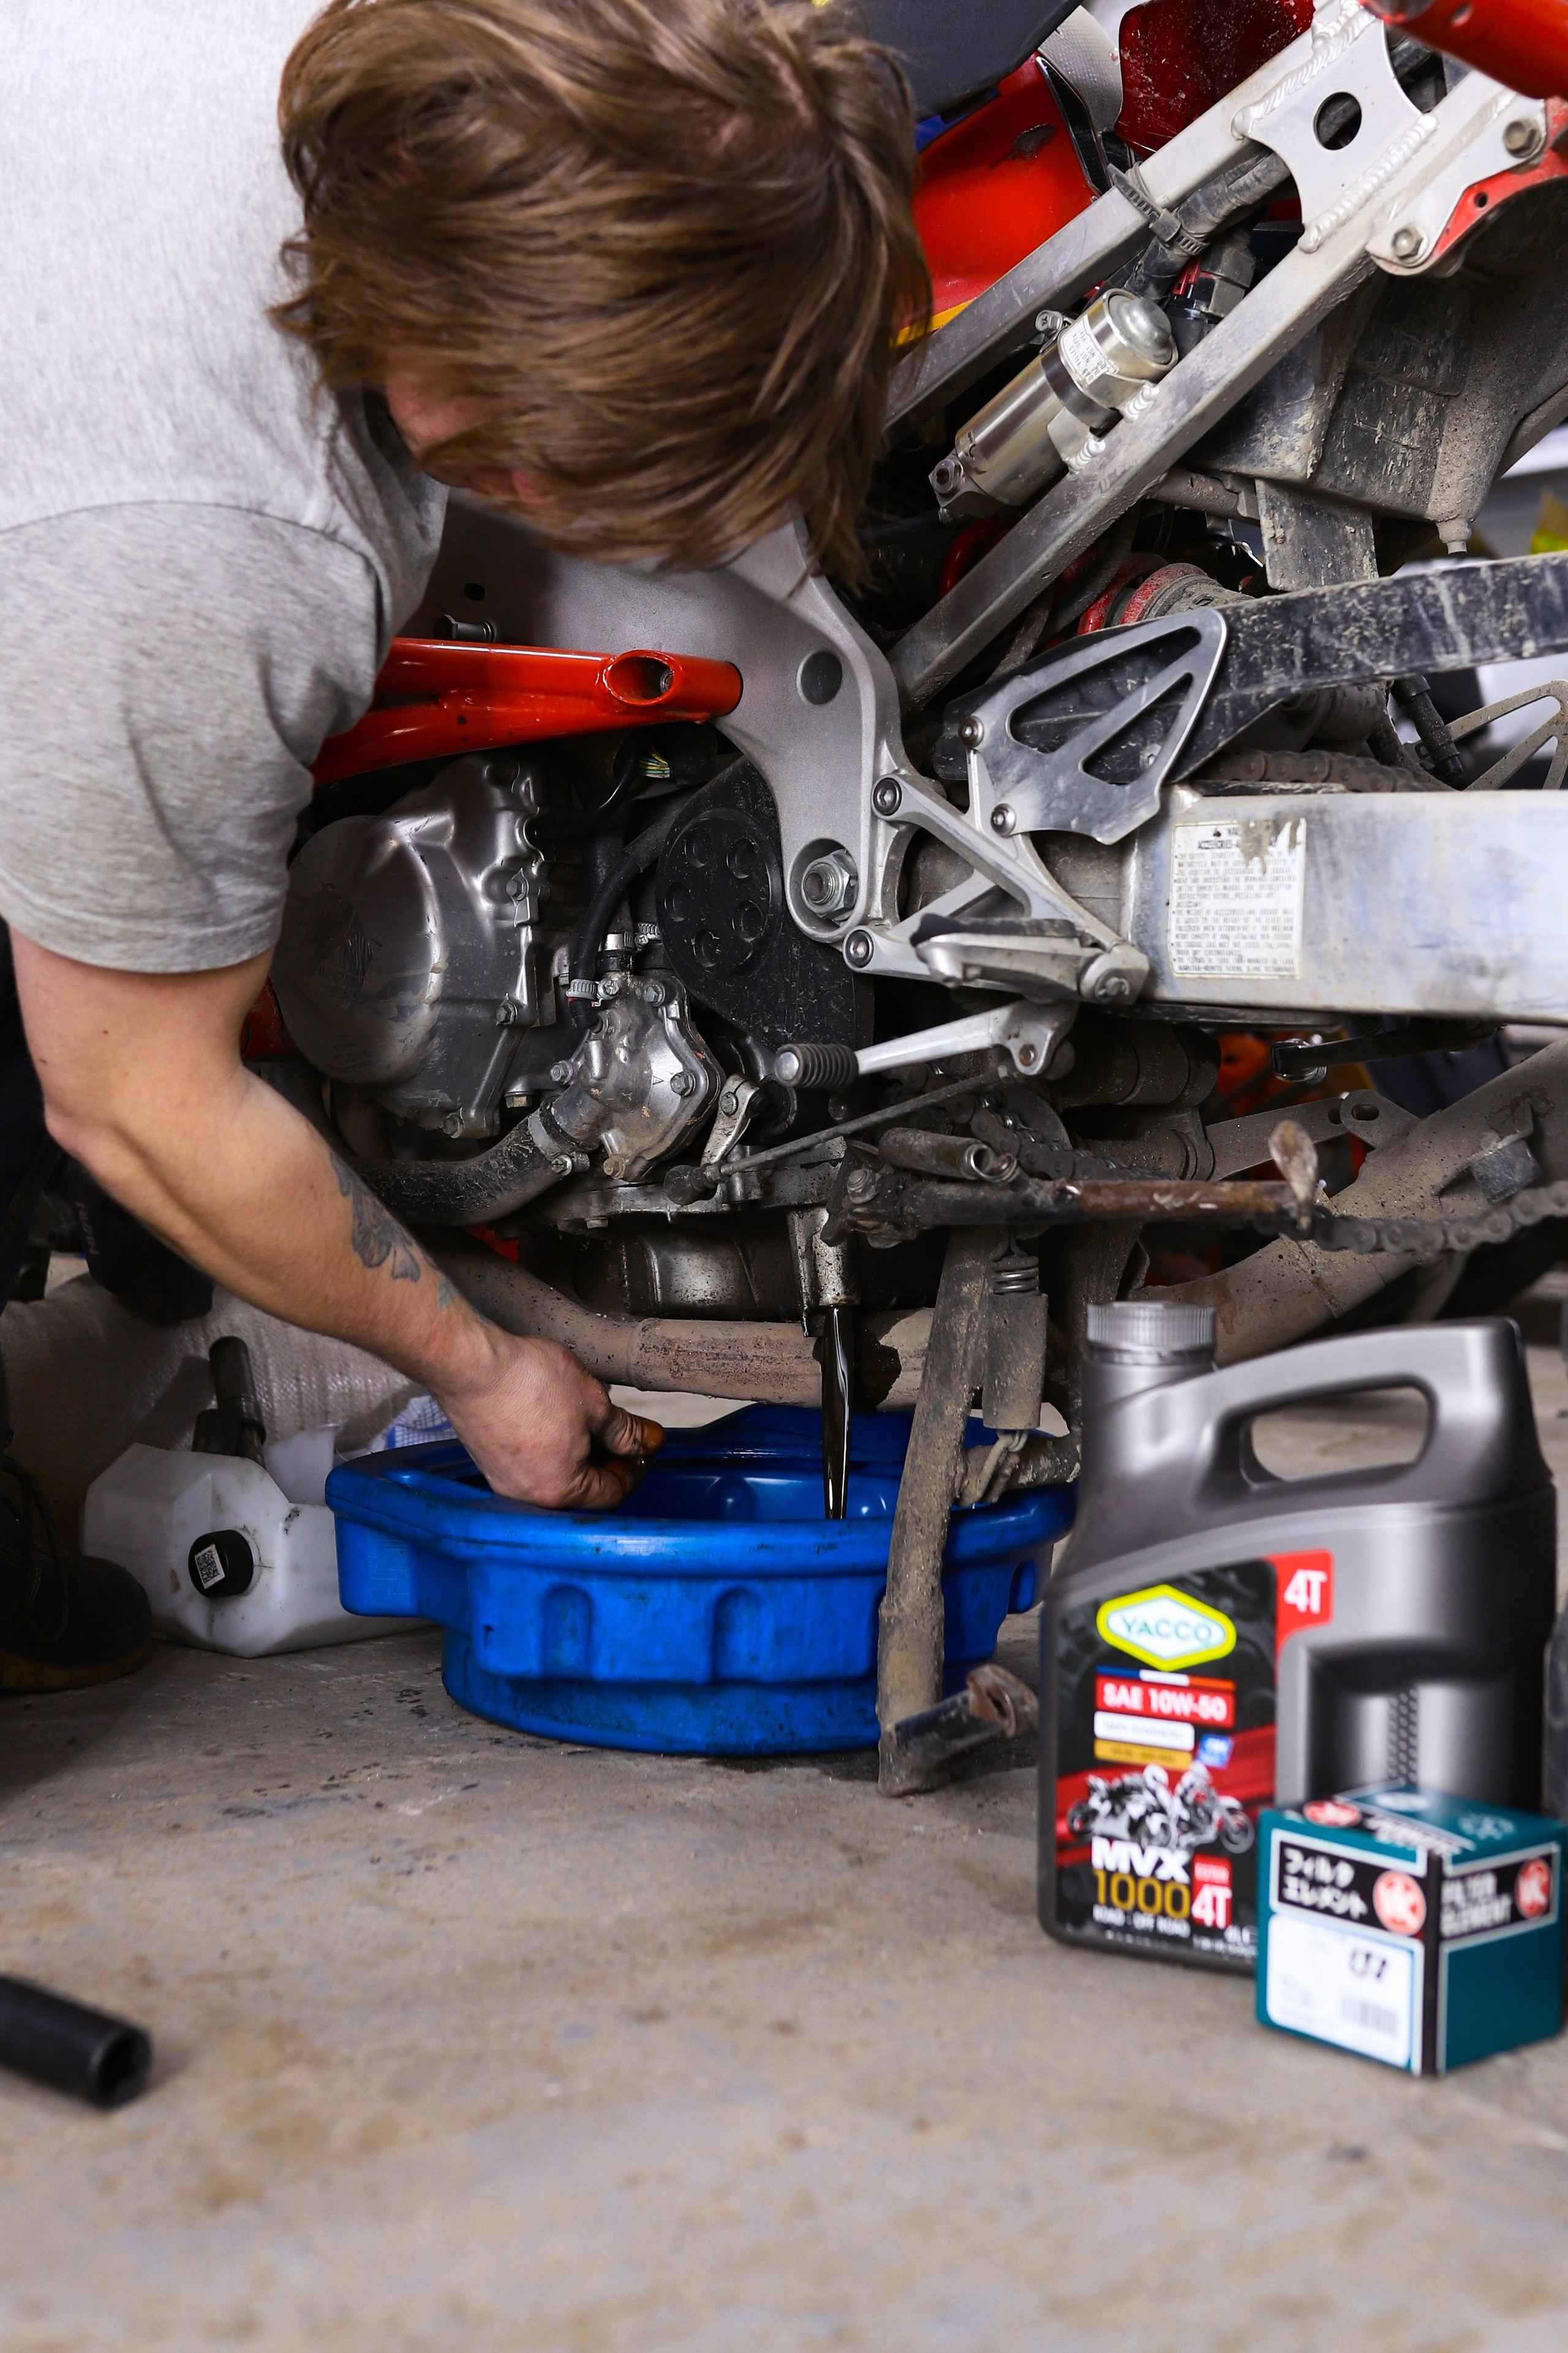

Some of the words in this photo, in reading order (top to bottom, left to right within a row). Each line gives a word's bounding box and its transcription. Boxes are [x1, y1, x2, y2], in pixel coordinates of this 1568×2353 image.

[1080, 352, 1089, 363] NOT
[1087, 346, 1096, 358] NOT
[1283, 1569, 1328, 1614] 4T
[1121, 1615, 1212, 1642] YACCO
[1102, 1682, 1144, 1711] SAE
[1148, 1688, 1227, 1722] 10W-50
[1091, 1836, 1190, 1884] MVX
[1093, 1869, 1190, 1920] 1000
[1191, 1883, 1232, 1929] 4T
